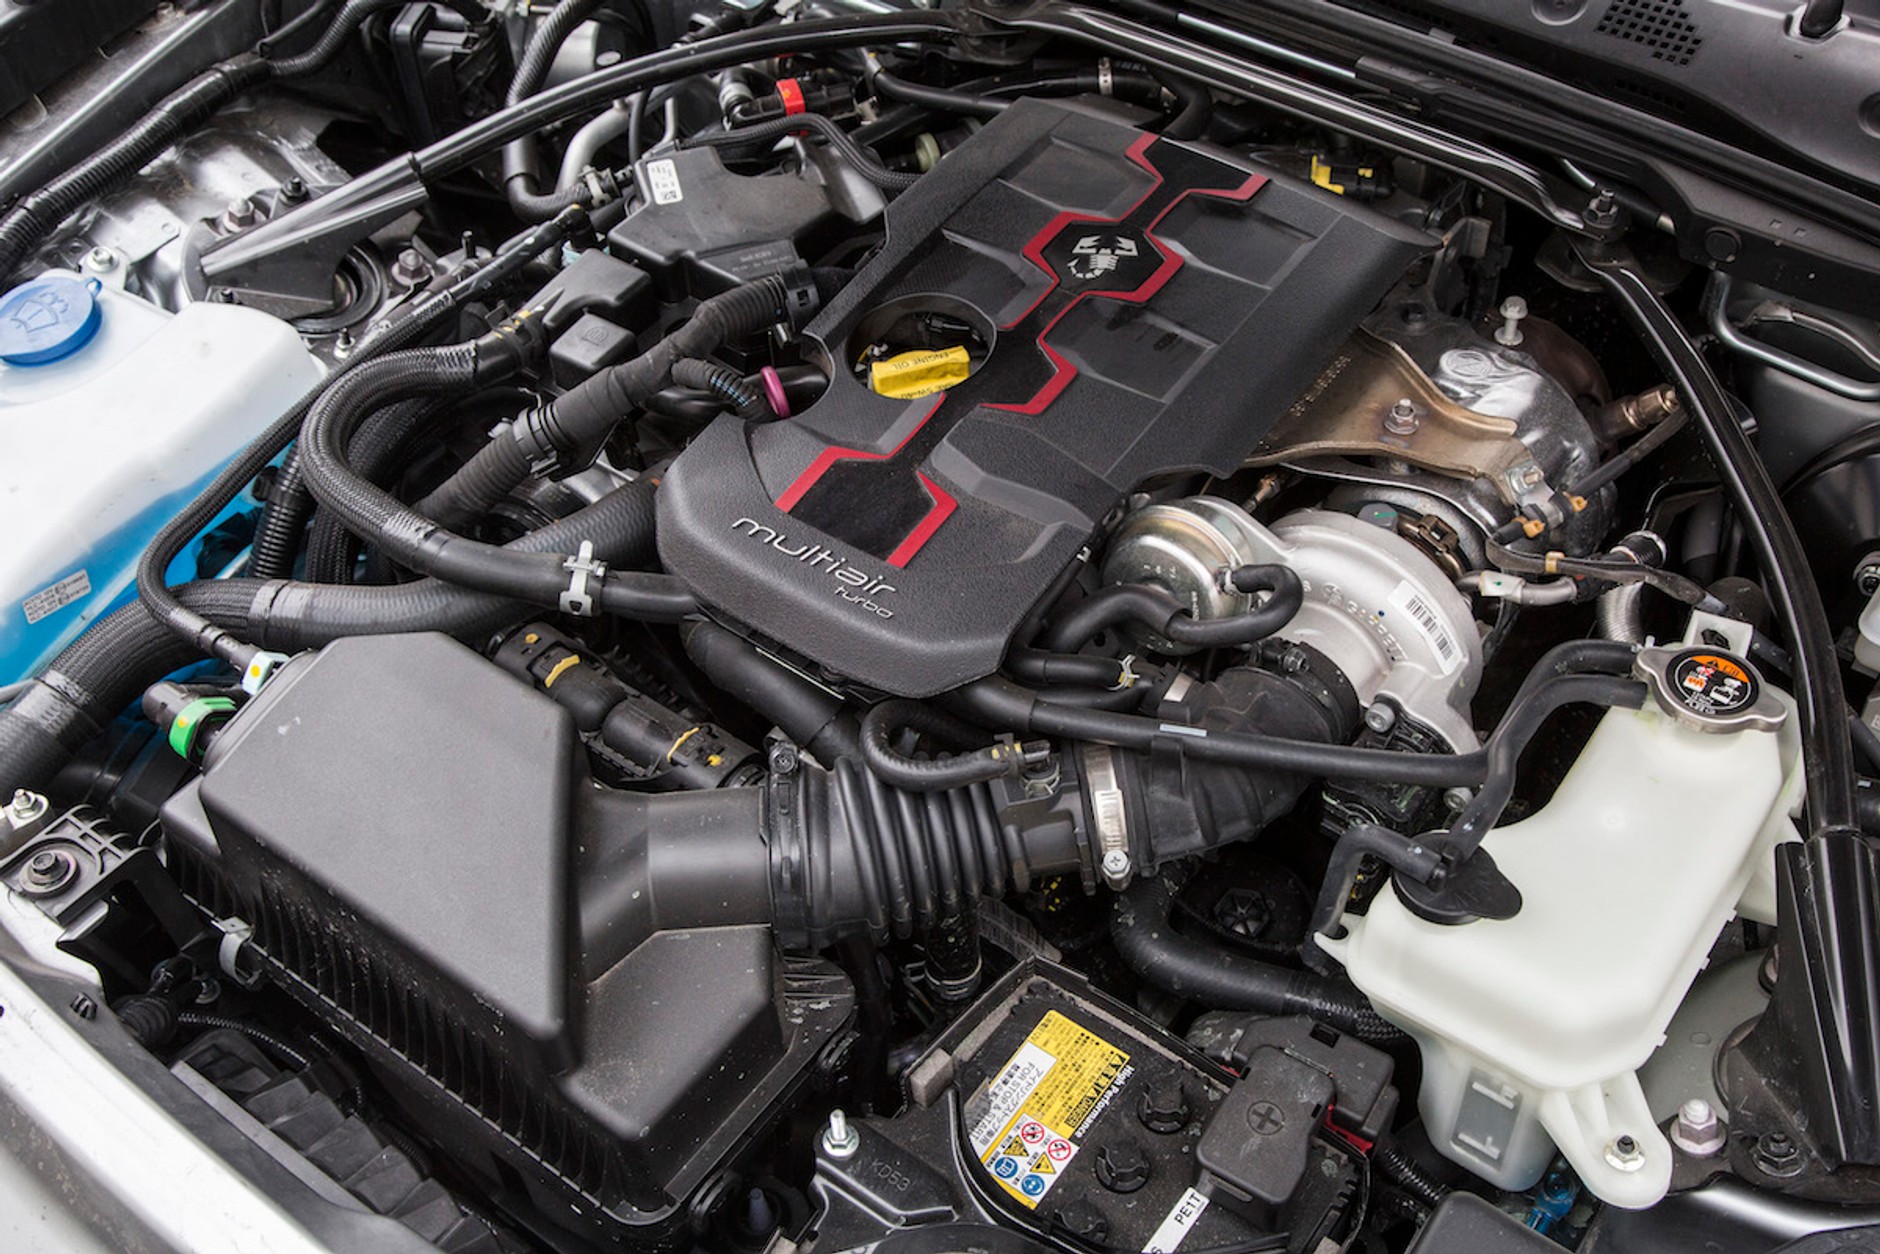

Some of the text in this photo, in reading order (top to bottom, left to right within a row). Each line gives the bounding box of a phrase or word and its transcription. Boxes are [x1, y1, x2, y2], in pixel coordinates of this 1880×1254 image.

[892, 351, 950, 371] ENGINE OIL
[732, 517, 896, 594] multiair
[834, 585, 895, 619] turbo
[1016, 1061, 1034, 1081] FOR
[998, 1079, 1020, 1105] STOP
[1073, 1063, 1134, 1139] High Performance
[991, 1103, 1001, 1113] &
[969, 1110, 996, 1141] START
[870, 1159, 910, 1191] KD53
